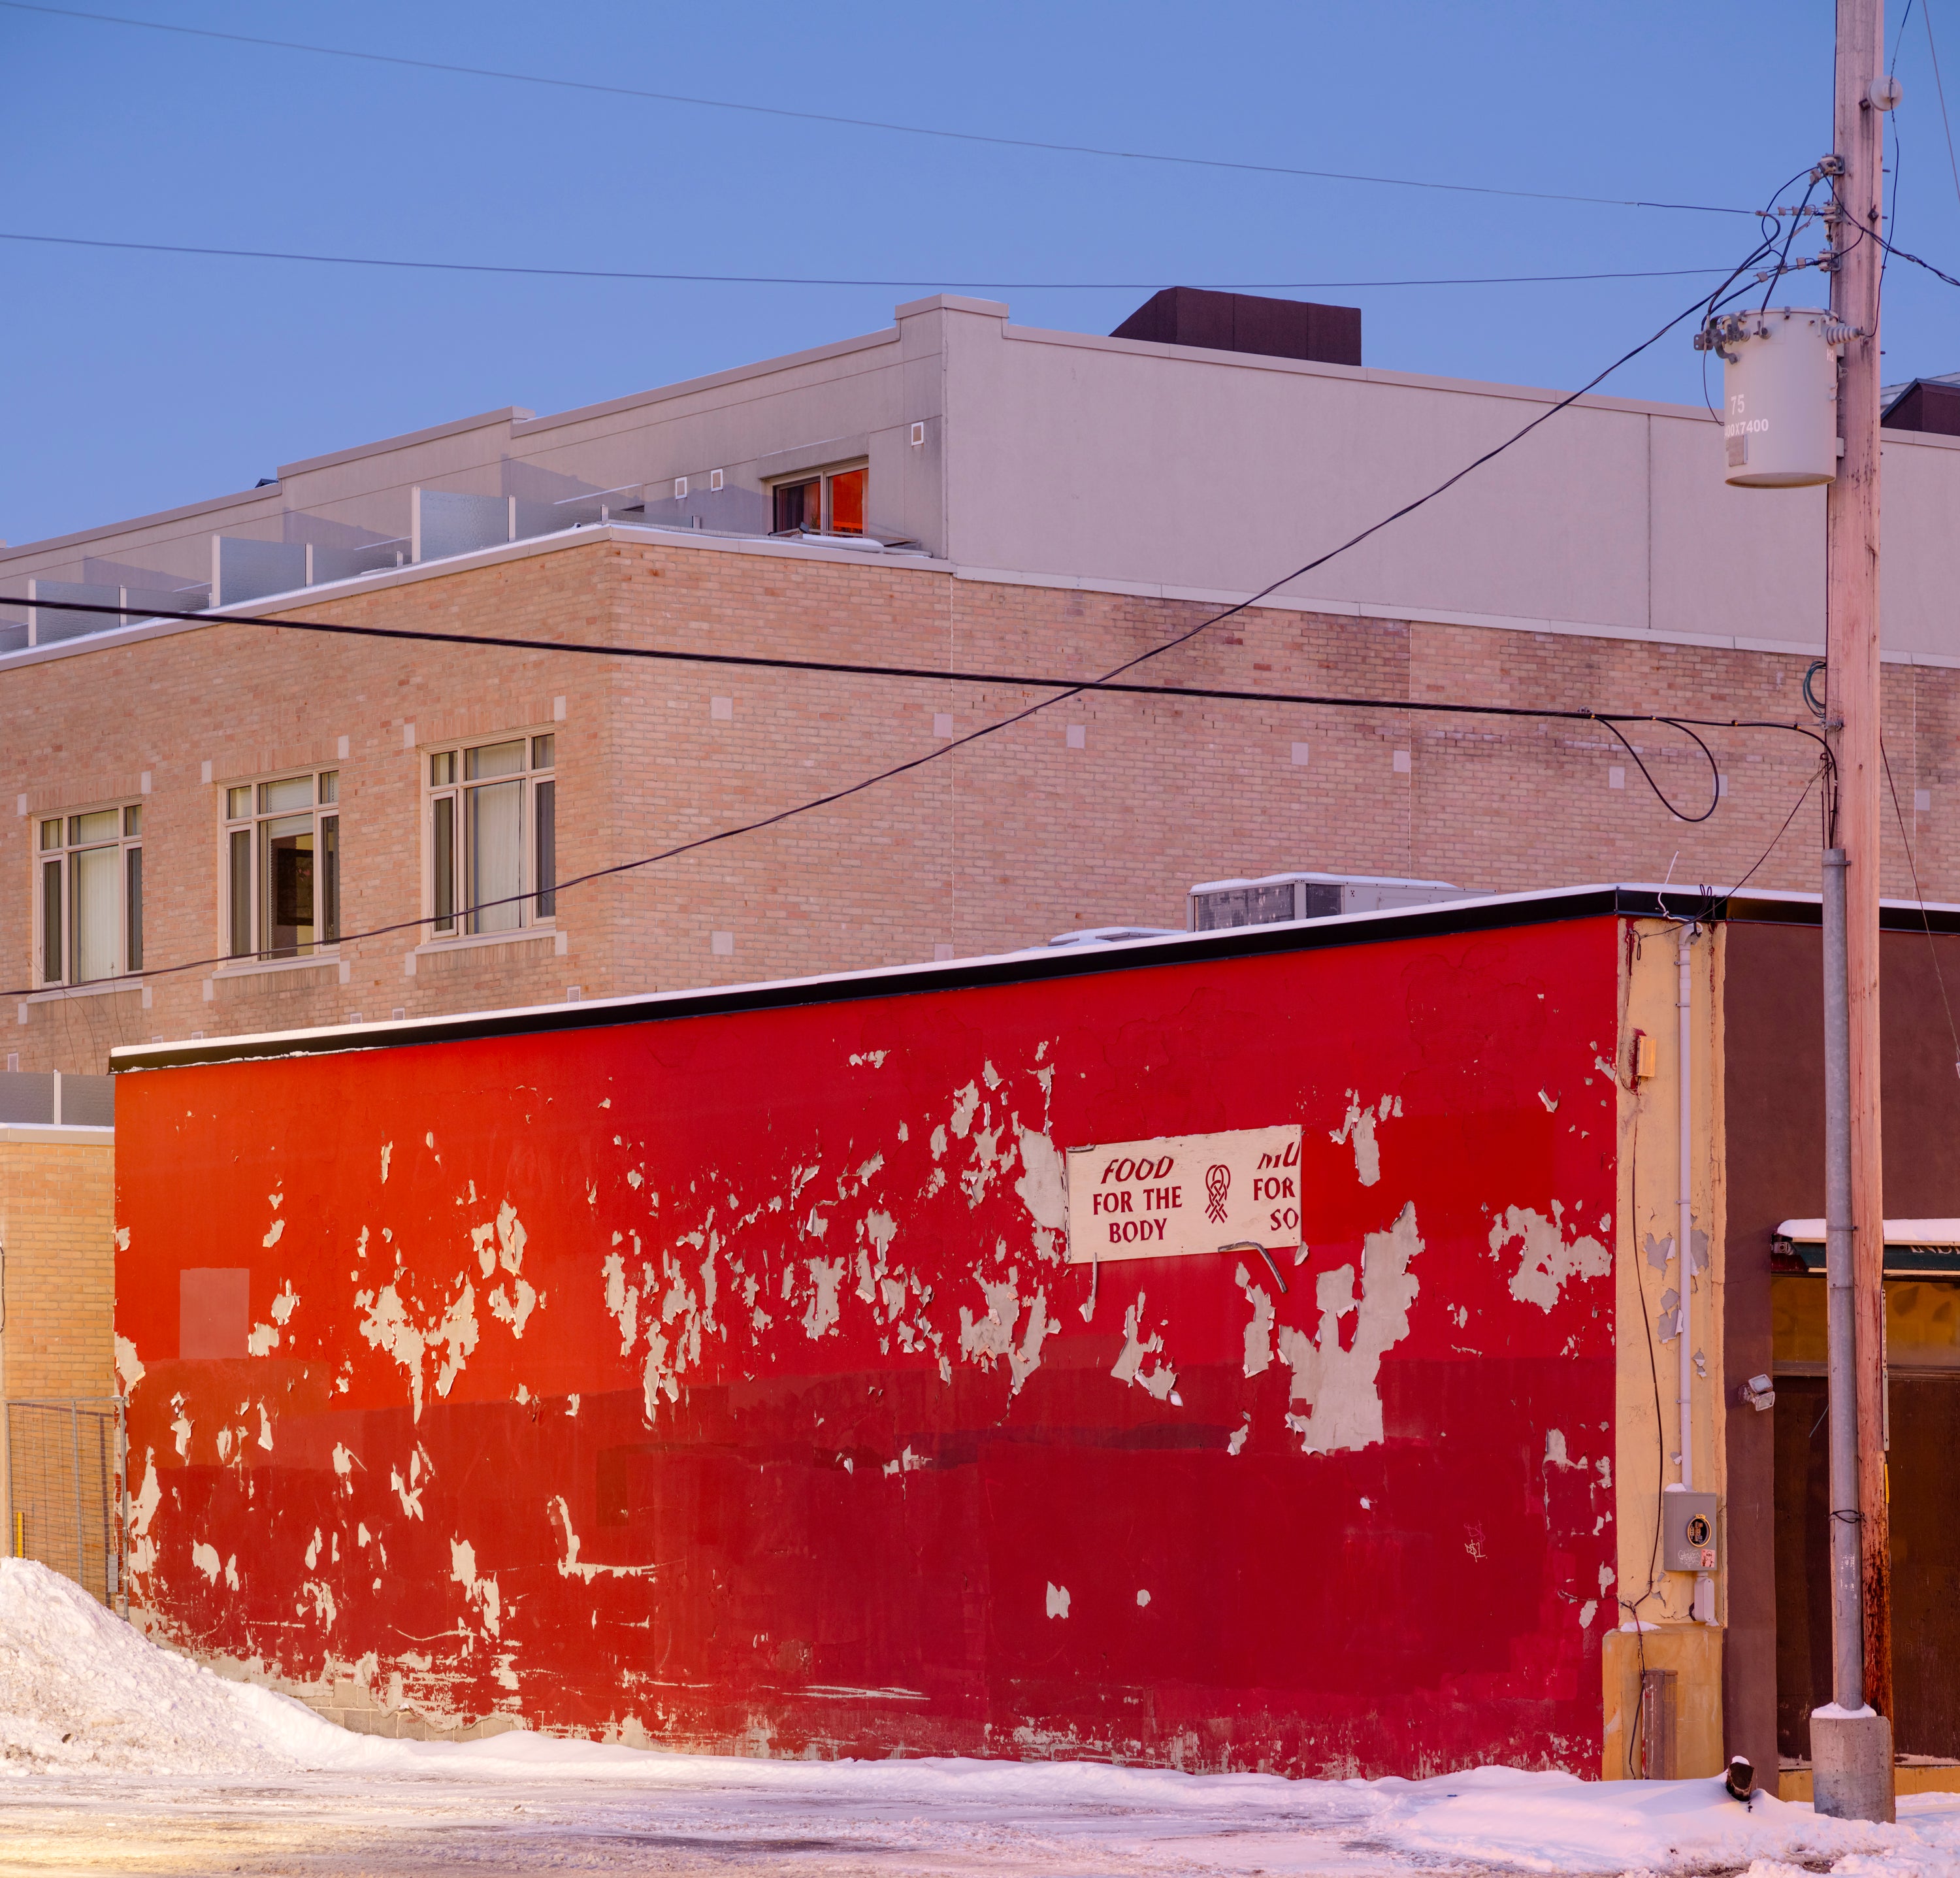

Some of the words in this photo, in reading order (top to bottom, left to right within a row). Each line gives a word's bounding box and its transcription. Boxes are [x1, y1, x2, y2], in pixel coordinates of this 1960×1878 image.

[1827, 349, 1834, 362] H2
[1731, 394, 1745, 416] 75
[1100, 1156, 1174, 1184] FOOD
[1092, 1191, 1134, 1215] FOR
[1143, 1185, 1183, 1211] THE
[1253, 1177, 1296, 1201] FOR
[1109, 1218, 1168, 1244] BODY
[1270, 1208, 1299, 1231] SO
